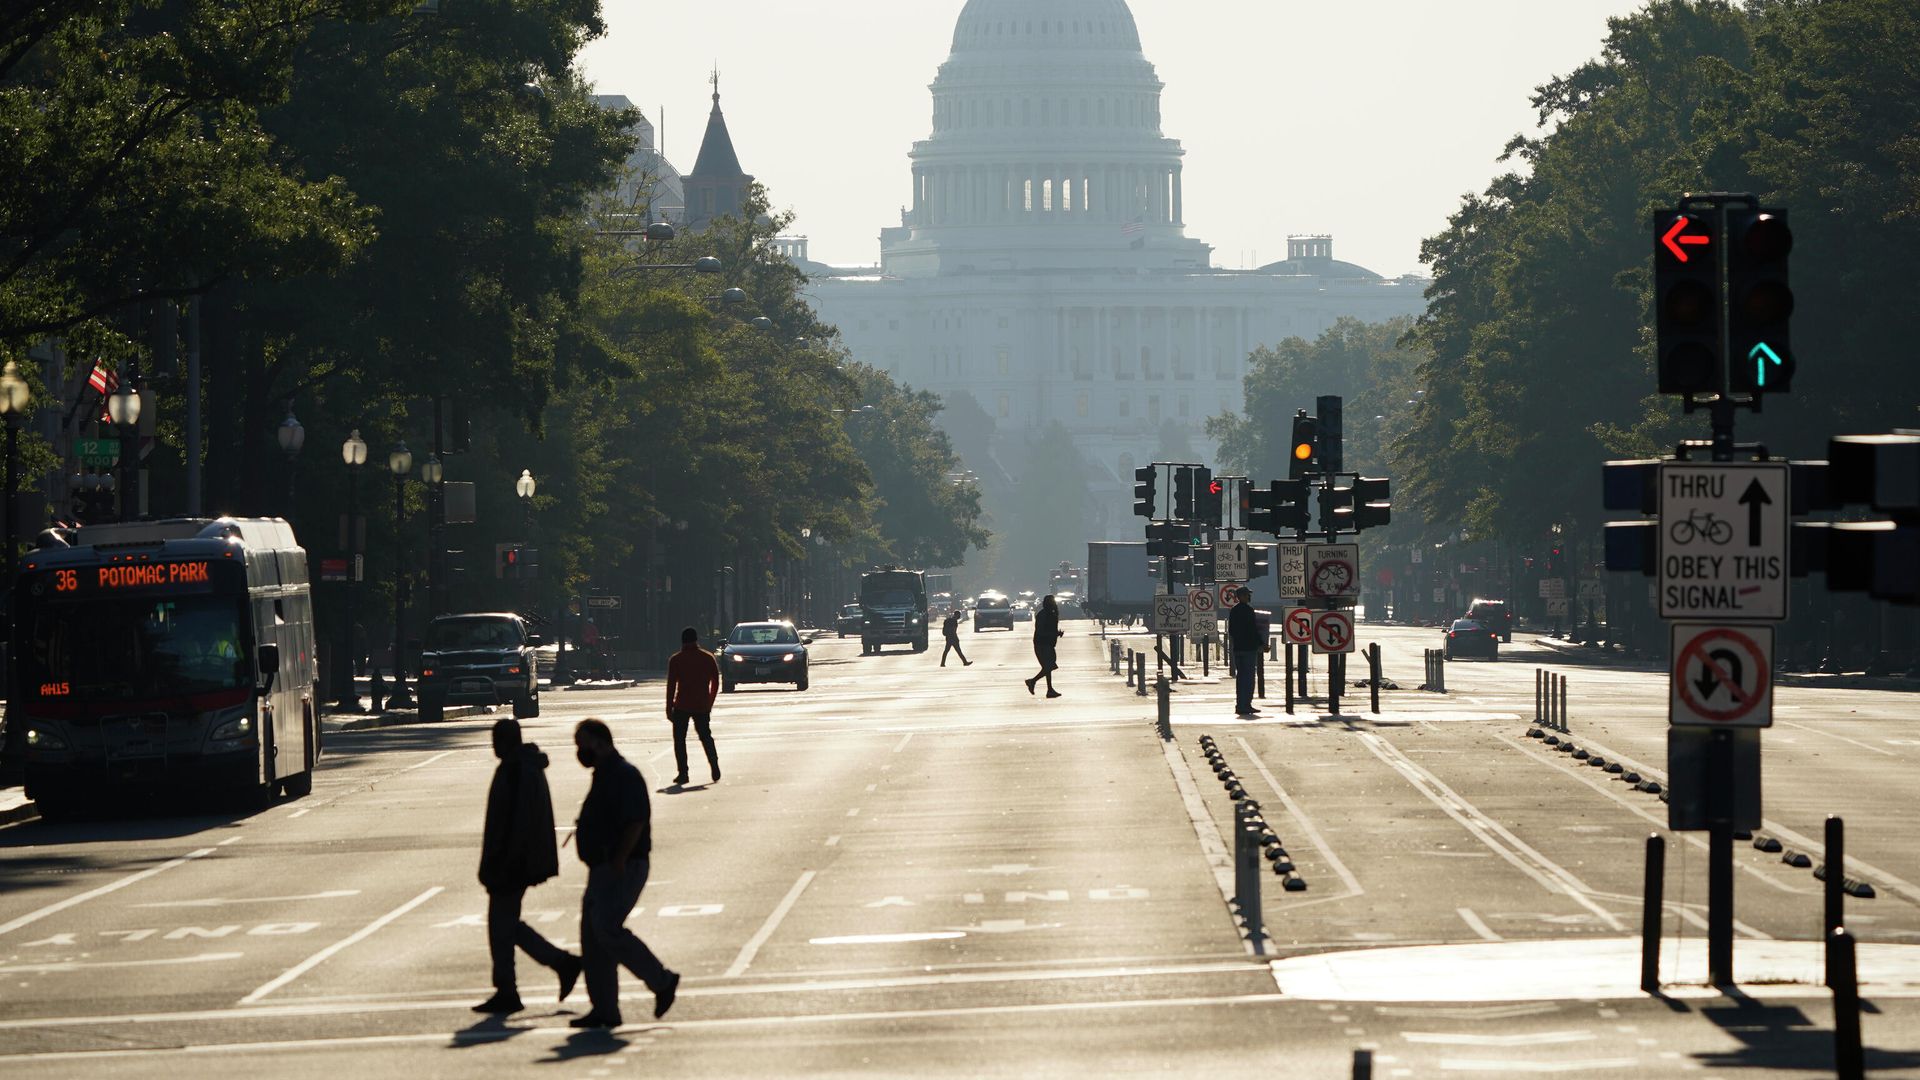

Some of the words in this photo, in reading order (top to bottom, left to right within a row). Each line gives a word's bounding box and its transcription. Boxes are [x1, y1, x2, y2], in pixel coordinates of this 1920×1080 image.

[82, 441, 98, 455] 12
[1668, 474, 1725, 499] THRU
[1217, 542, 1232, 550] THRU
[1282, 546, 1303, 556] THRU
[1317, 550, 1348, 559] TURNING
[1217, 563, 1232, 571] OBEY
[1666, 555, 1724, 580] OBEY
[1733, 556, 1780, 580] THIS
[55, 569, 78, 592] 36
[99, 564, 166, 587] POTOMAC
[169, 561, 209, 583] PARK
[1281, 575, 1303, 585] OBEY
[1281, 586, 1305, 596] SIGNA
[1666, 585, 1743, 609] SIGNAL
[40, 682, 70, 696] AH15
[17, 922, 322, 947] ONLY
